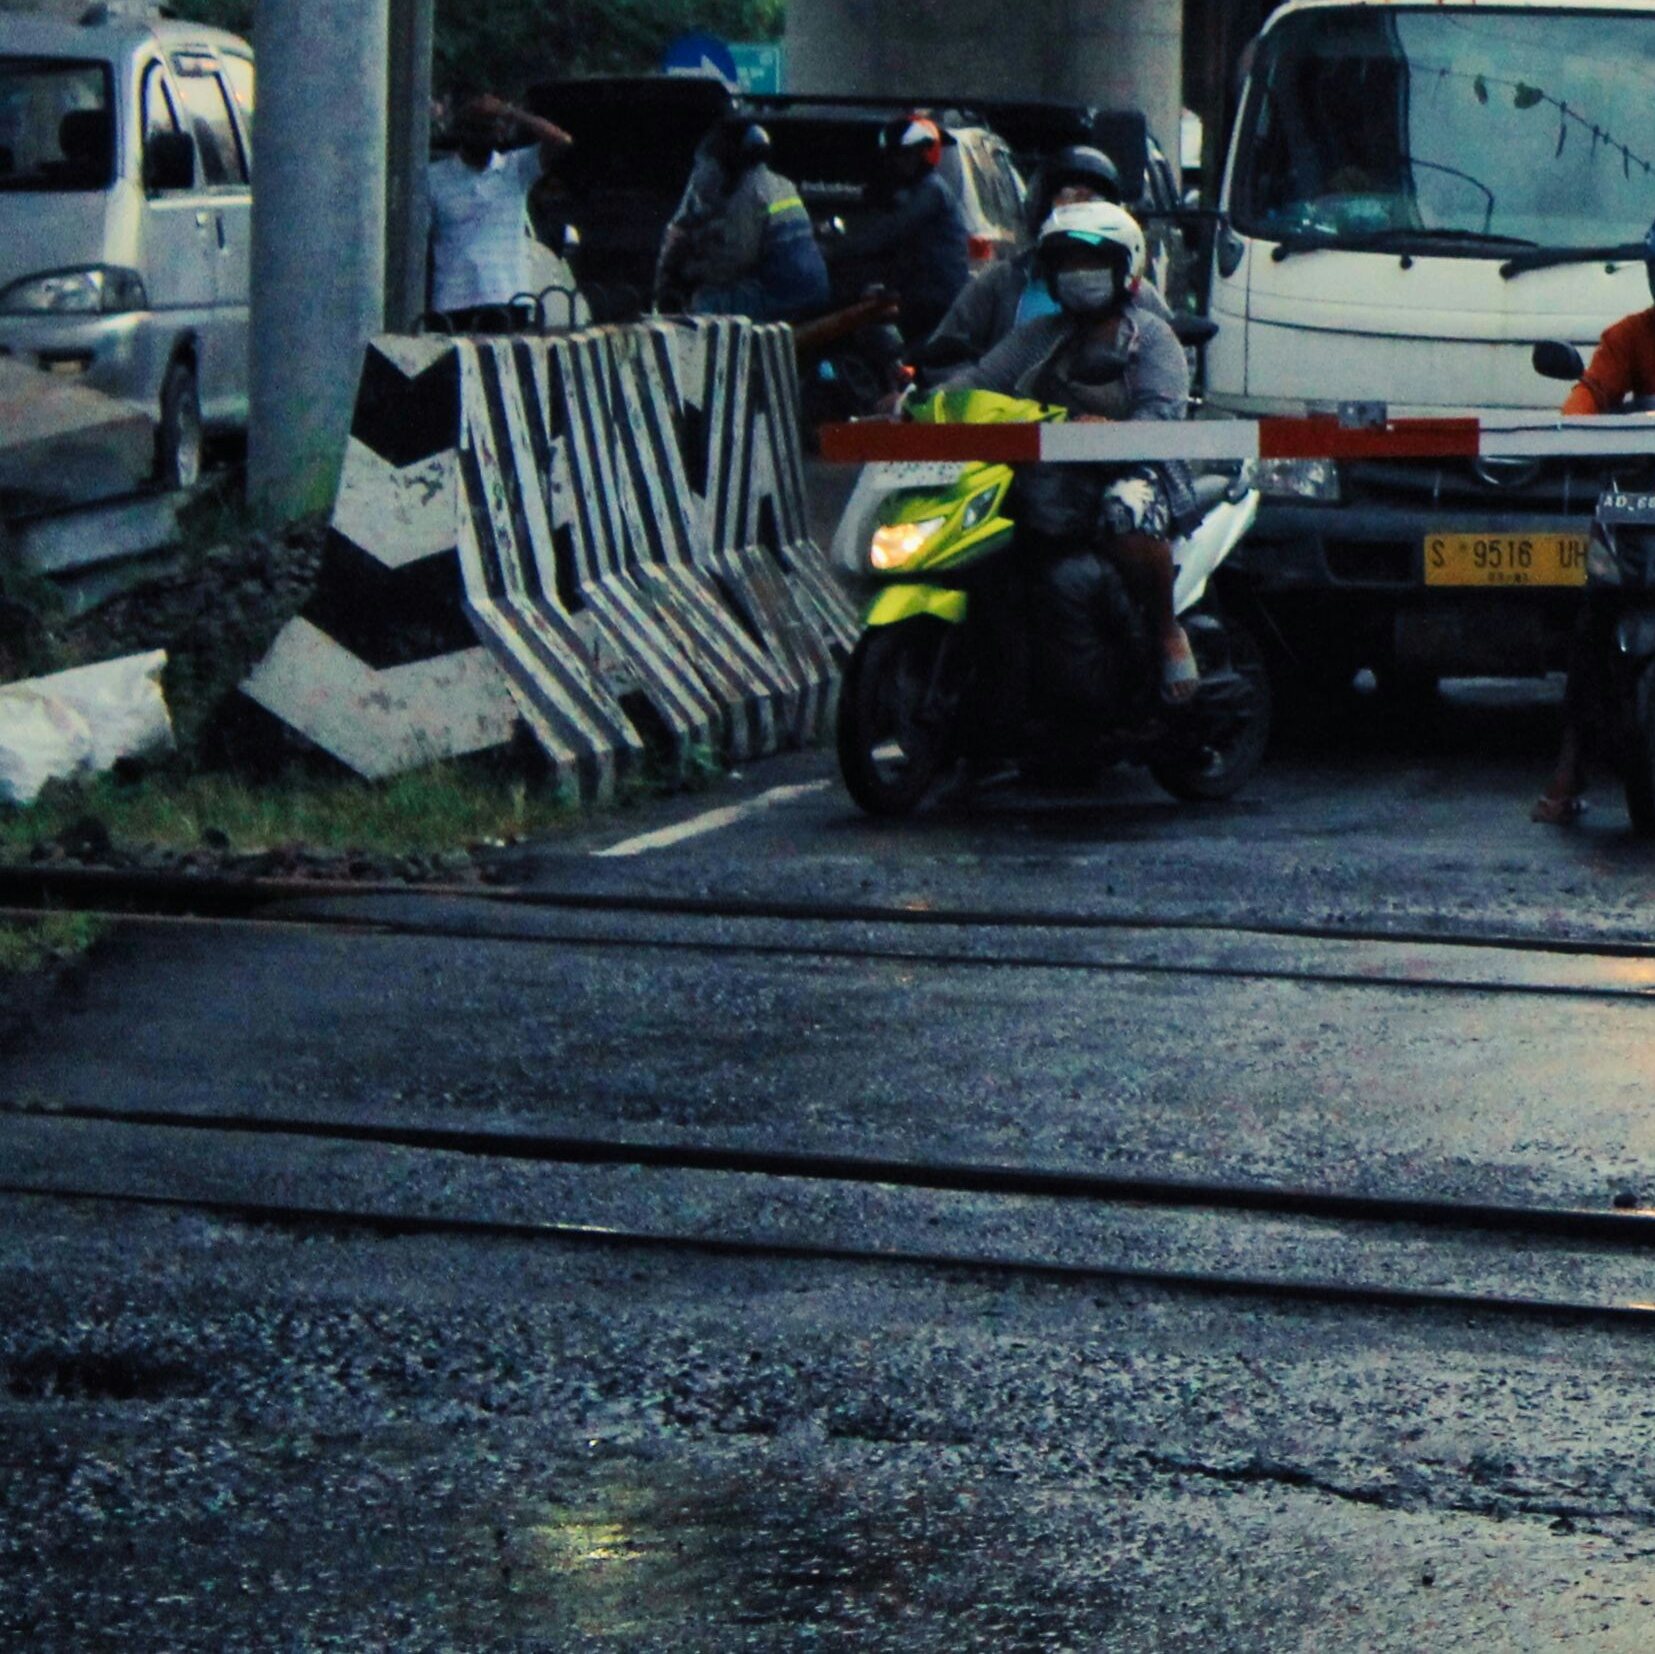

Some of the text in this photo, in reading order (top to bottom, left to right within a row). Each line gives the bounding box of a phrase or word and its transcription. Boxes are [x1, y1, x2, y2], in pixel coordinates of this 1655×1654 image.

[1603, 495, 1627, 508] AD
[1431, 539, 1446, 568] S
[1474, 540, 1533, 569] 9516
